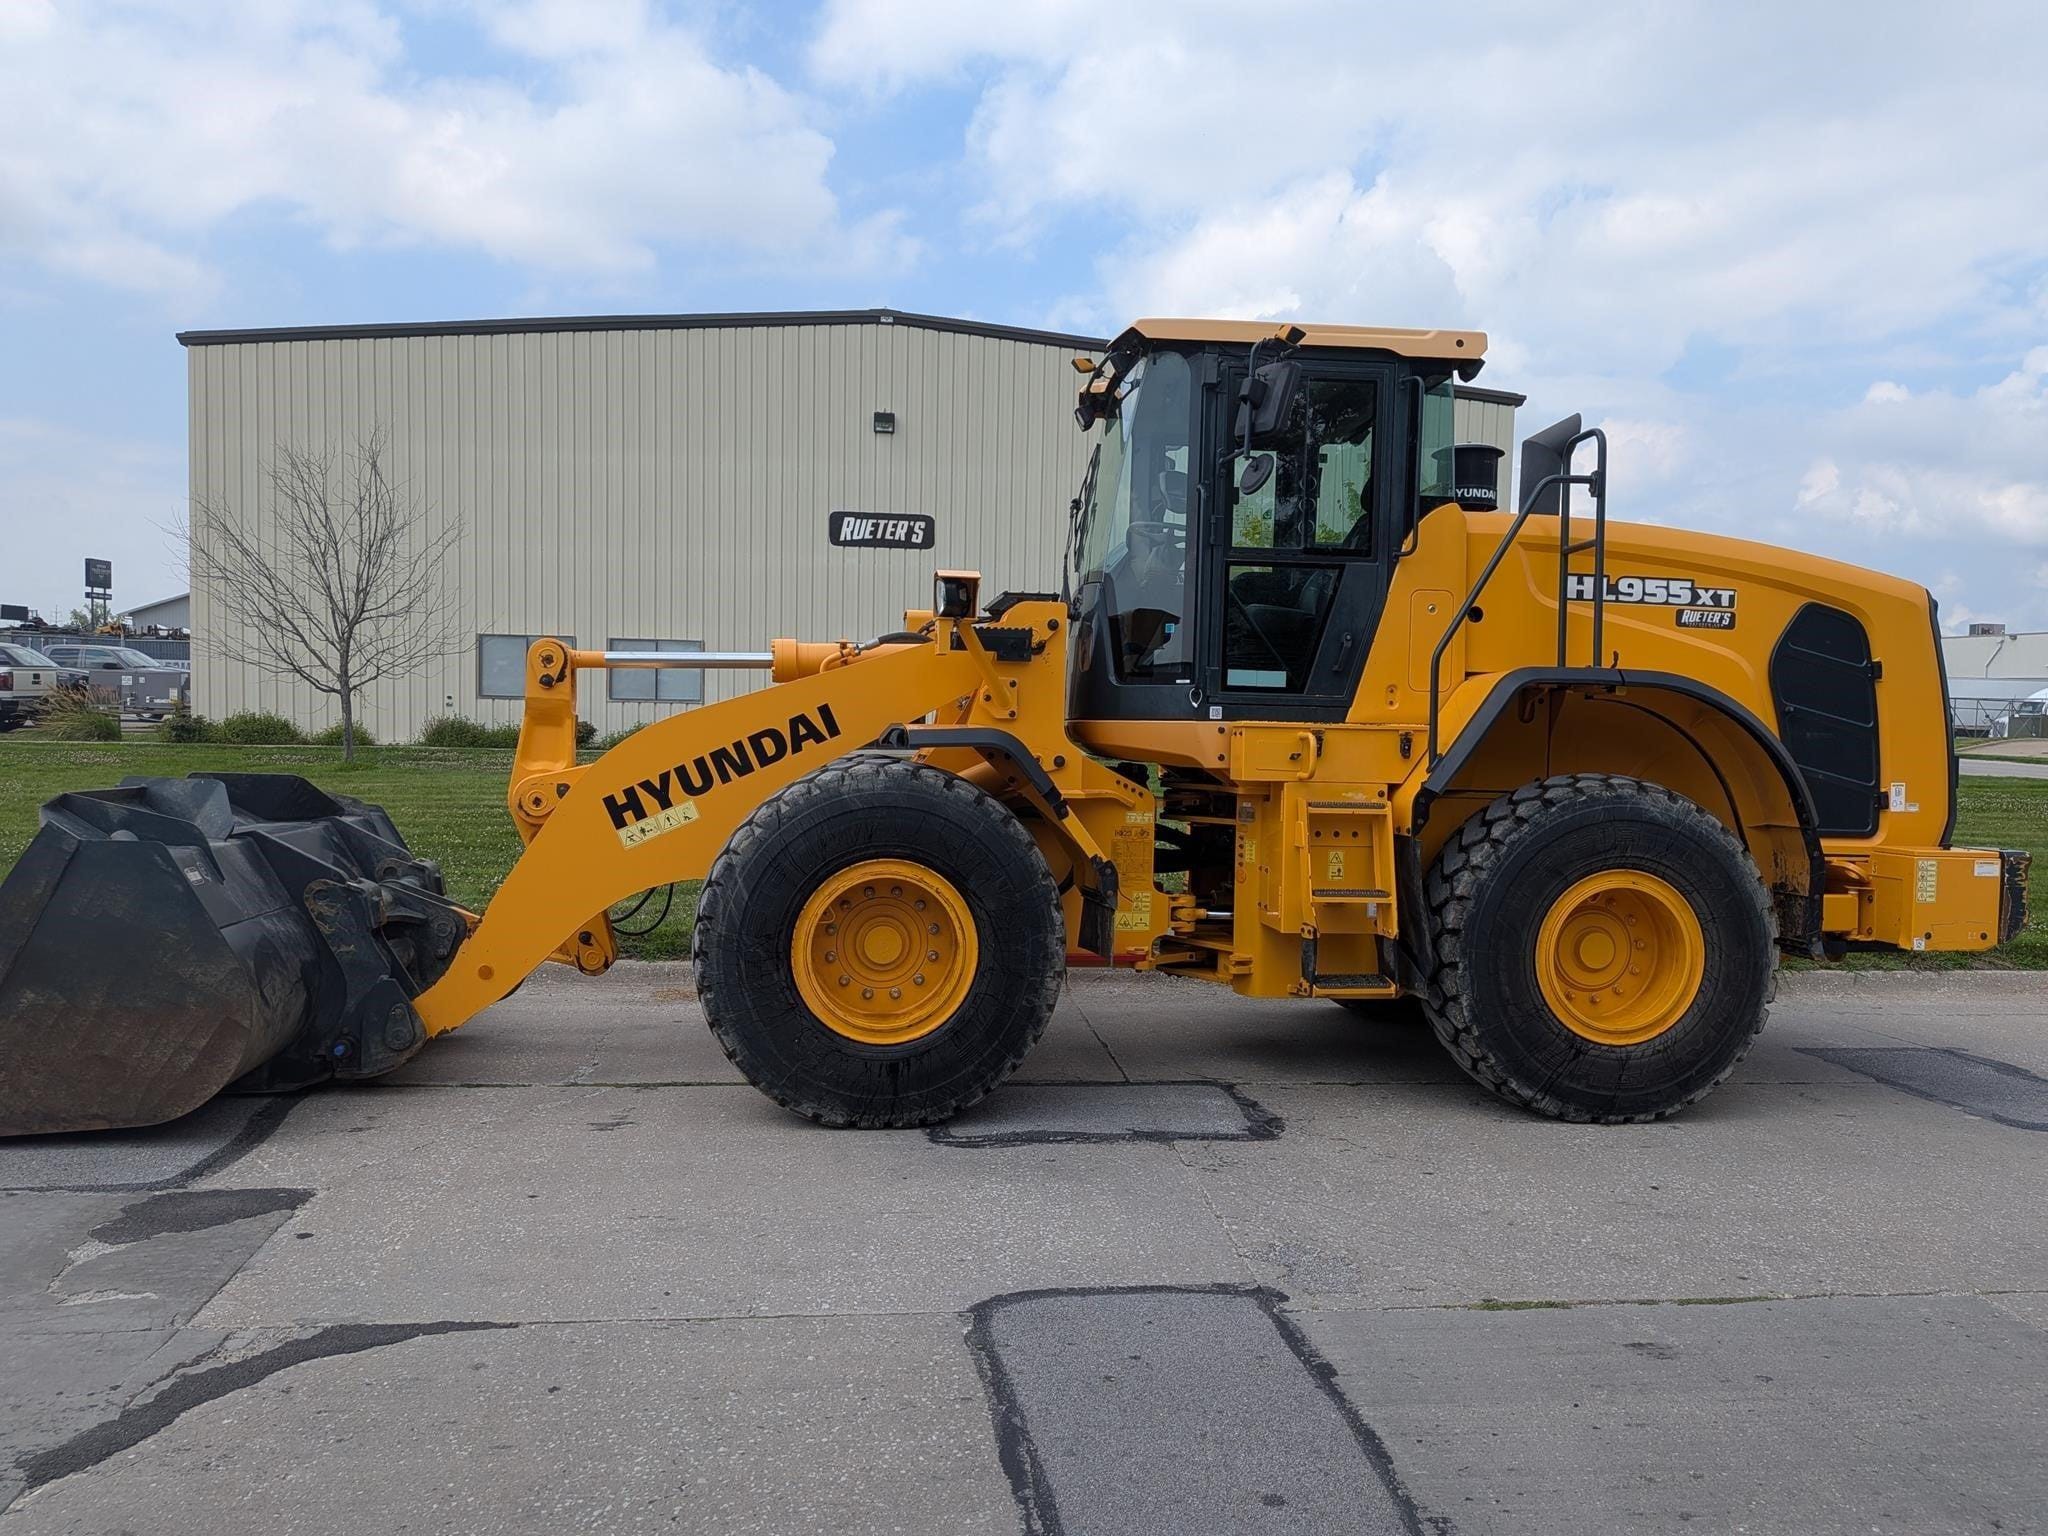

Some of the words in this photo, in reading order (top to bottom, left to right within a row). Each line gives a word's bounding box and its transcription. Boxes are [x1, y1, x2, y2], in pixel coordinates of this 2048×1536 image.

[839, 516, 926, 544] RUETER'S
[1681, 609, 1731, 625] RUETER'S
[602, 703, 842, 830] HYUNDAI
